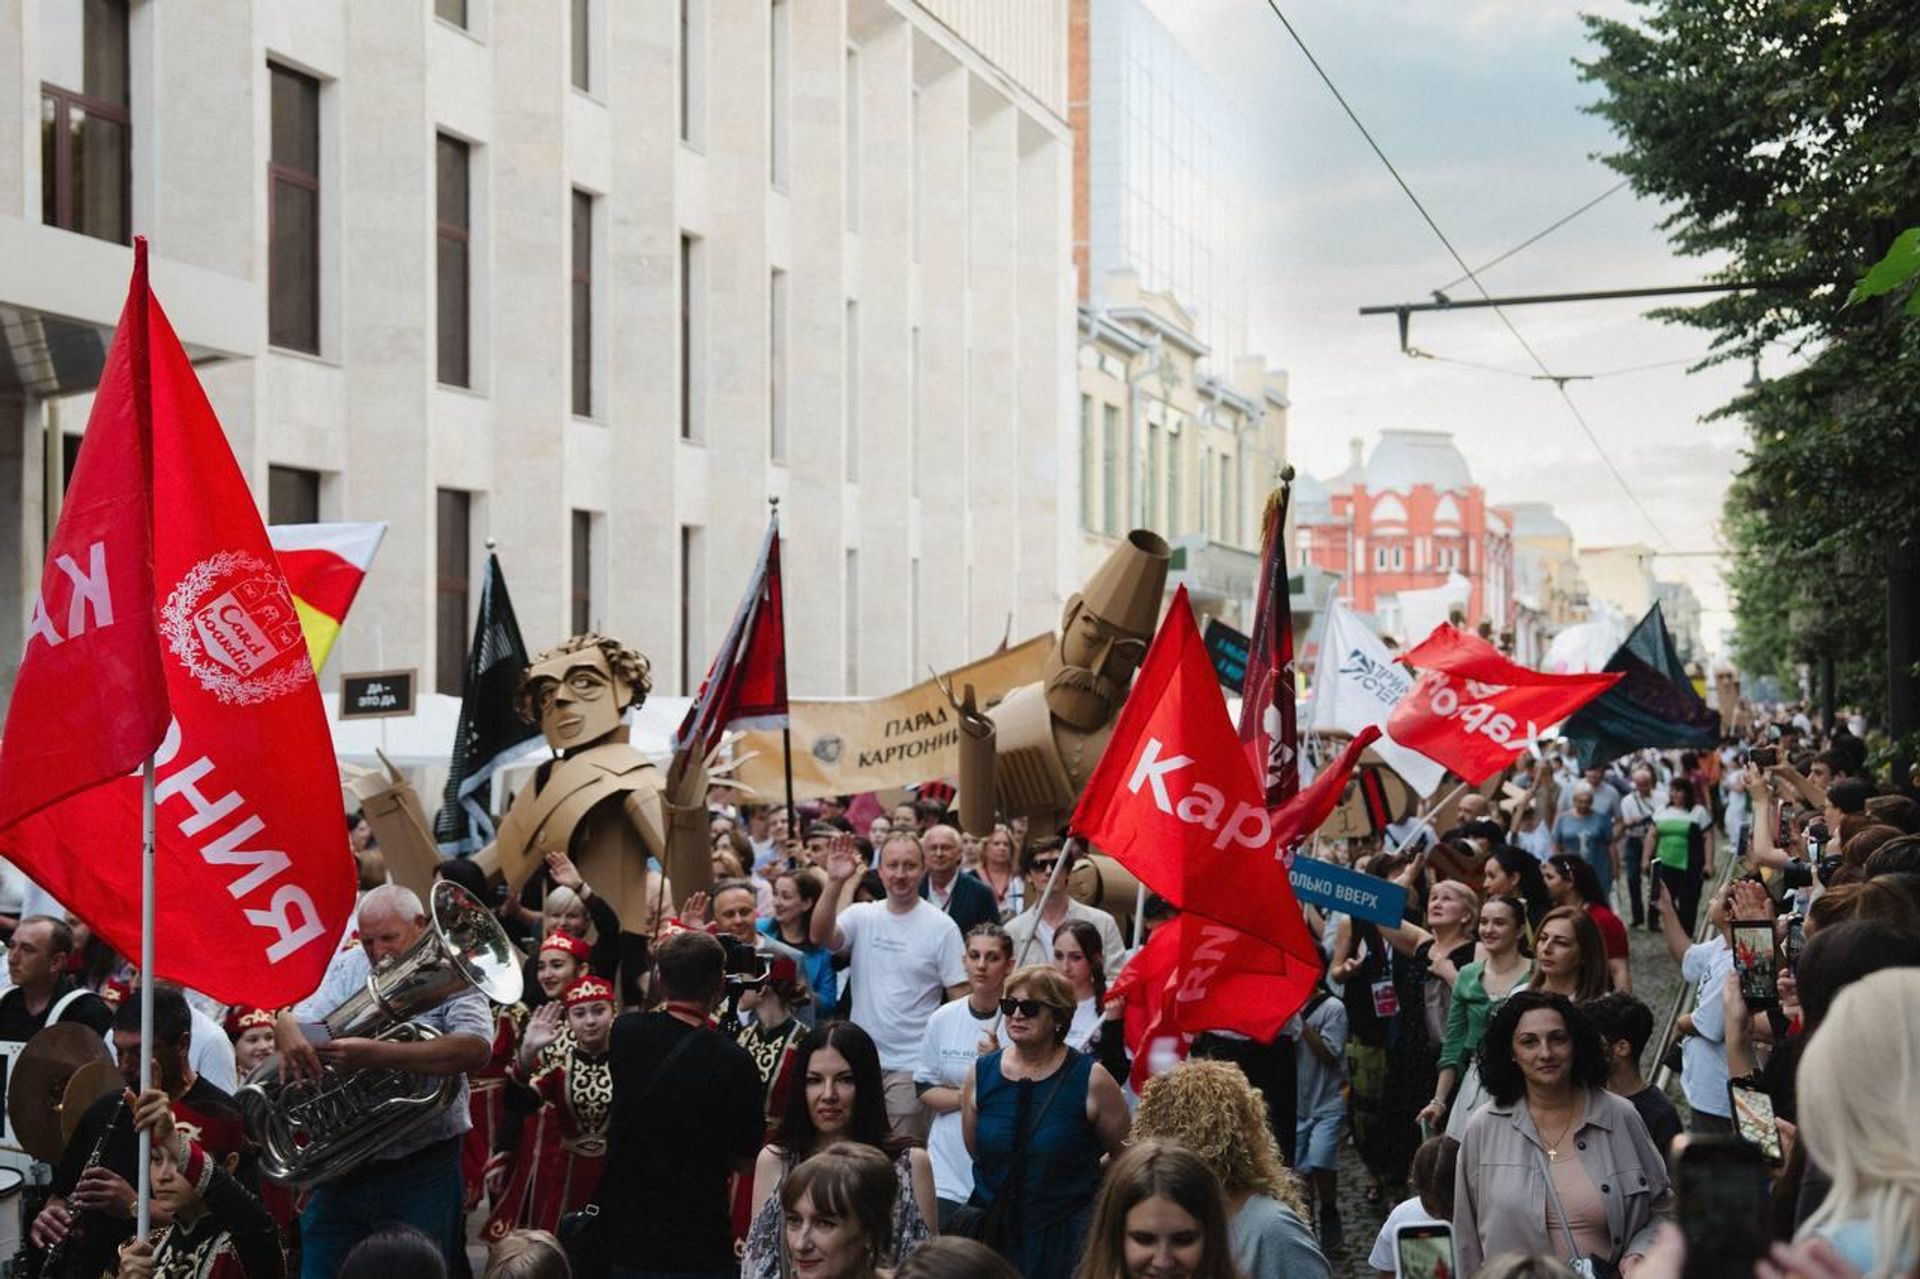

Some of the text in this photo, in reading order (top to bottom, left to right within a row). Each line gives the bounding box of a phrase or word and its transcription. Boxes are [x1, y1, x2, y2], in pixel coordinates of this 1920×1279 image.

[884, 706, 948, 738] ПАРАД
[1289, 870, 1379, 909] ОЛЬКО ВВЕРХ
